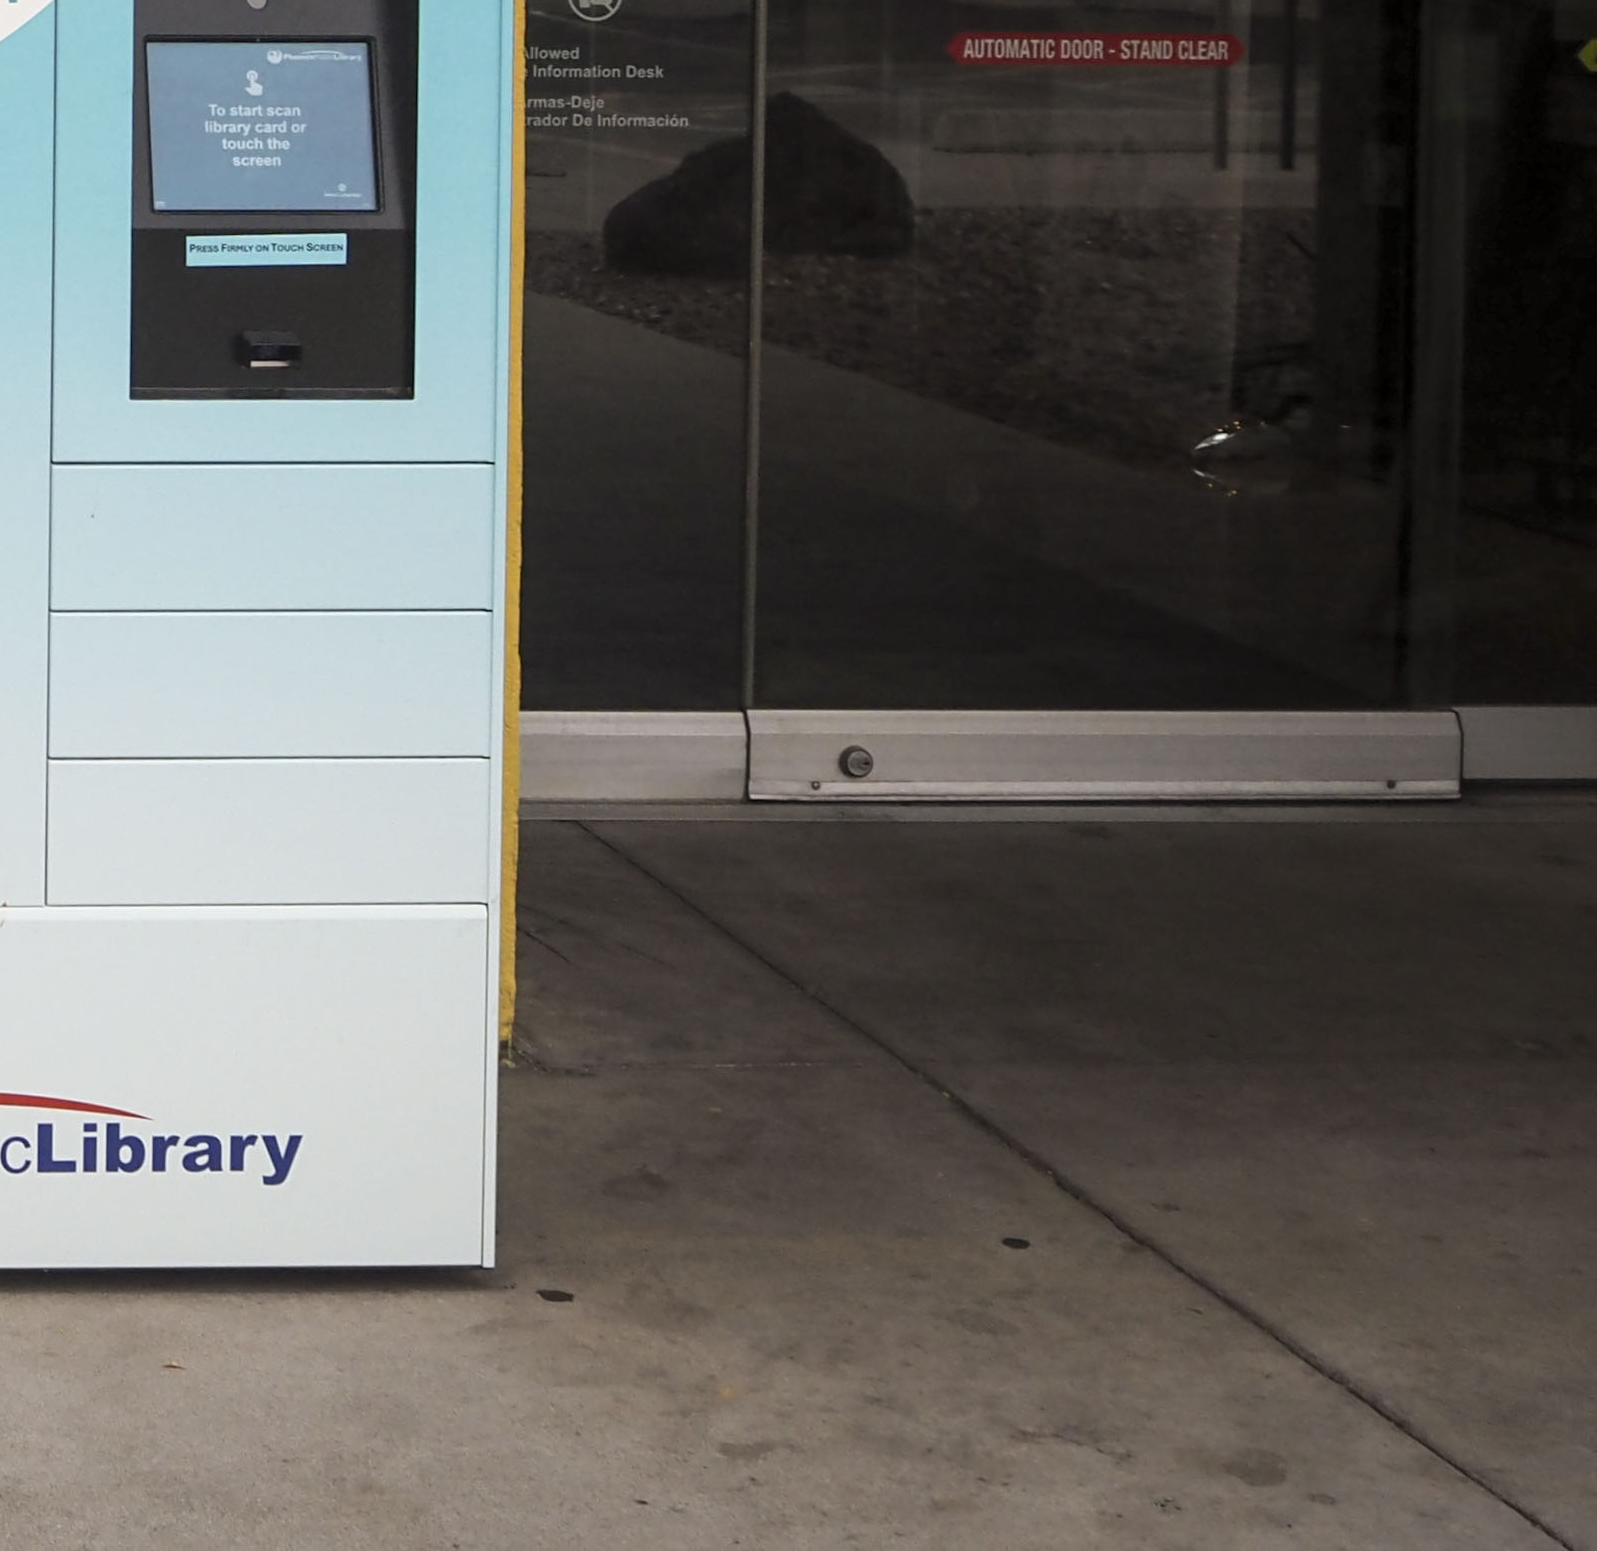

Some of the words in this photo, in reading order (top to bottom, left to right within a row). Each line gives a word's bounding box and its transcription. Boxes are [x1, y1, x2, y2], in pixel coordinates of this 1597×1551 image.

[963, 39, 1055, 59] AUTOMATIC
[1060, 39, 1103, 59] DOOR
[1120, 40, 1173, 61] STAND
[1178, 41, 1229, 61] CLEAR
[533, 64, 622, 78] Information
[625, 64, 664, 78] Desk
[209, 104, 225, 116] To
[230, 105, 263, 116] start
[267, 107, 301, 116] scan
[526, 95, 605, 112] rmas-Deje
[573, 115, 593, 127] De
[597, 114, 689, 128] Información
[205, 121, 250, 136] library
[255, 121, 286, 133] card
[291, 124, 306, 133] or
[222, 138, 263, 150] touch
[267, 138, 290, 150] the
[233, 156, 281, 166] screen
